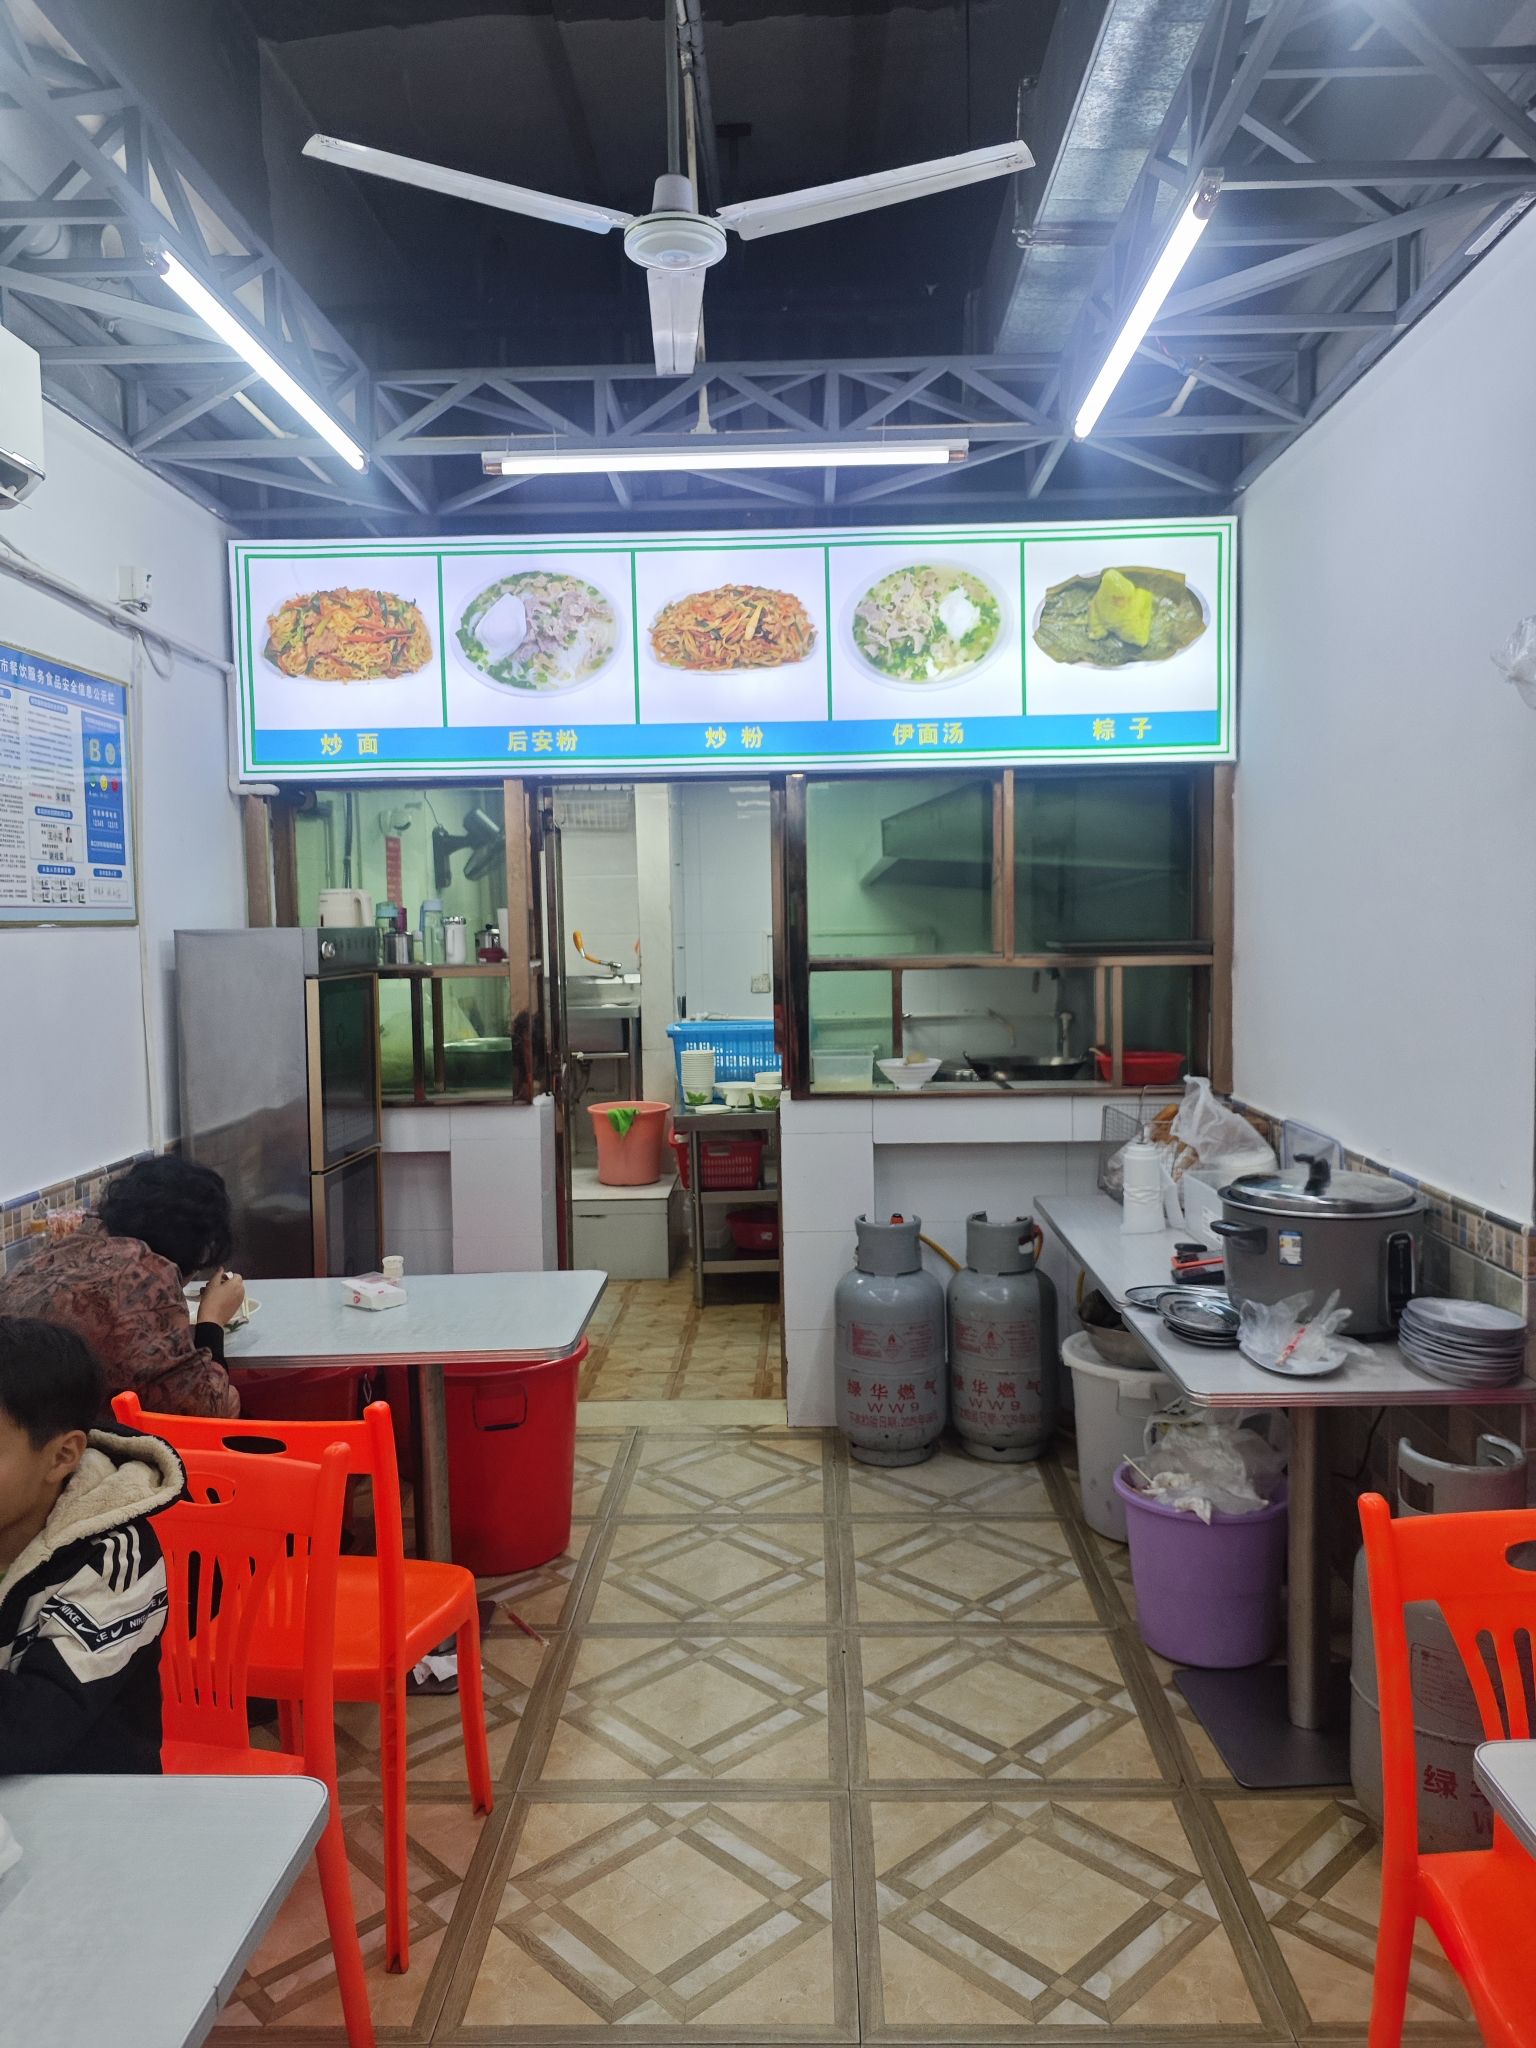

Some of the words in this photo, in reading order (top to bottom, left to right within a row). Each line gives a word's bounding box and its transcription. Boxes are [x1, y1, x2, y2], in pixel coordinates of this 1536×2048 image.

[704, 725, 764, 749] 炒粉
[892, 721, 965, 746] 伊面汤
[1092, 716, 1152, 741] 粽子
[320, 732, 379, 756] 炒面
[507, 729, 579, 753] 后安粉
[867, 1402, 920, 1414] WW9
[59, 1604, 82, 1625] NIKE
